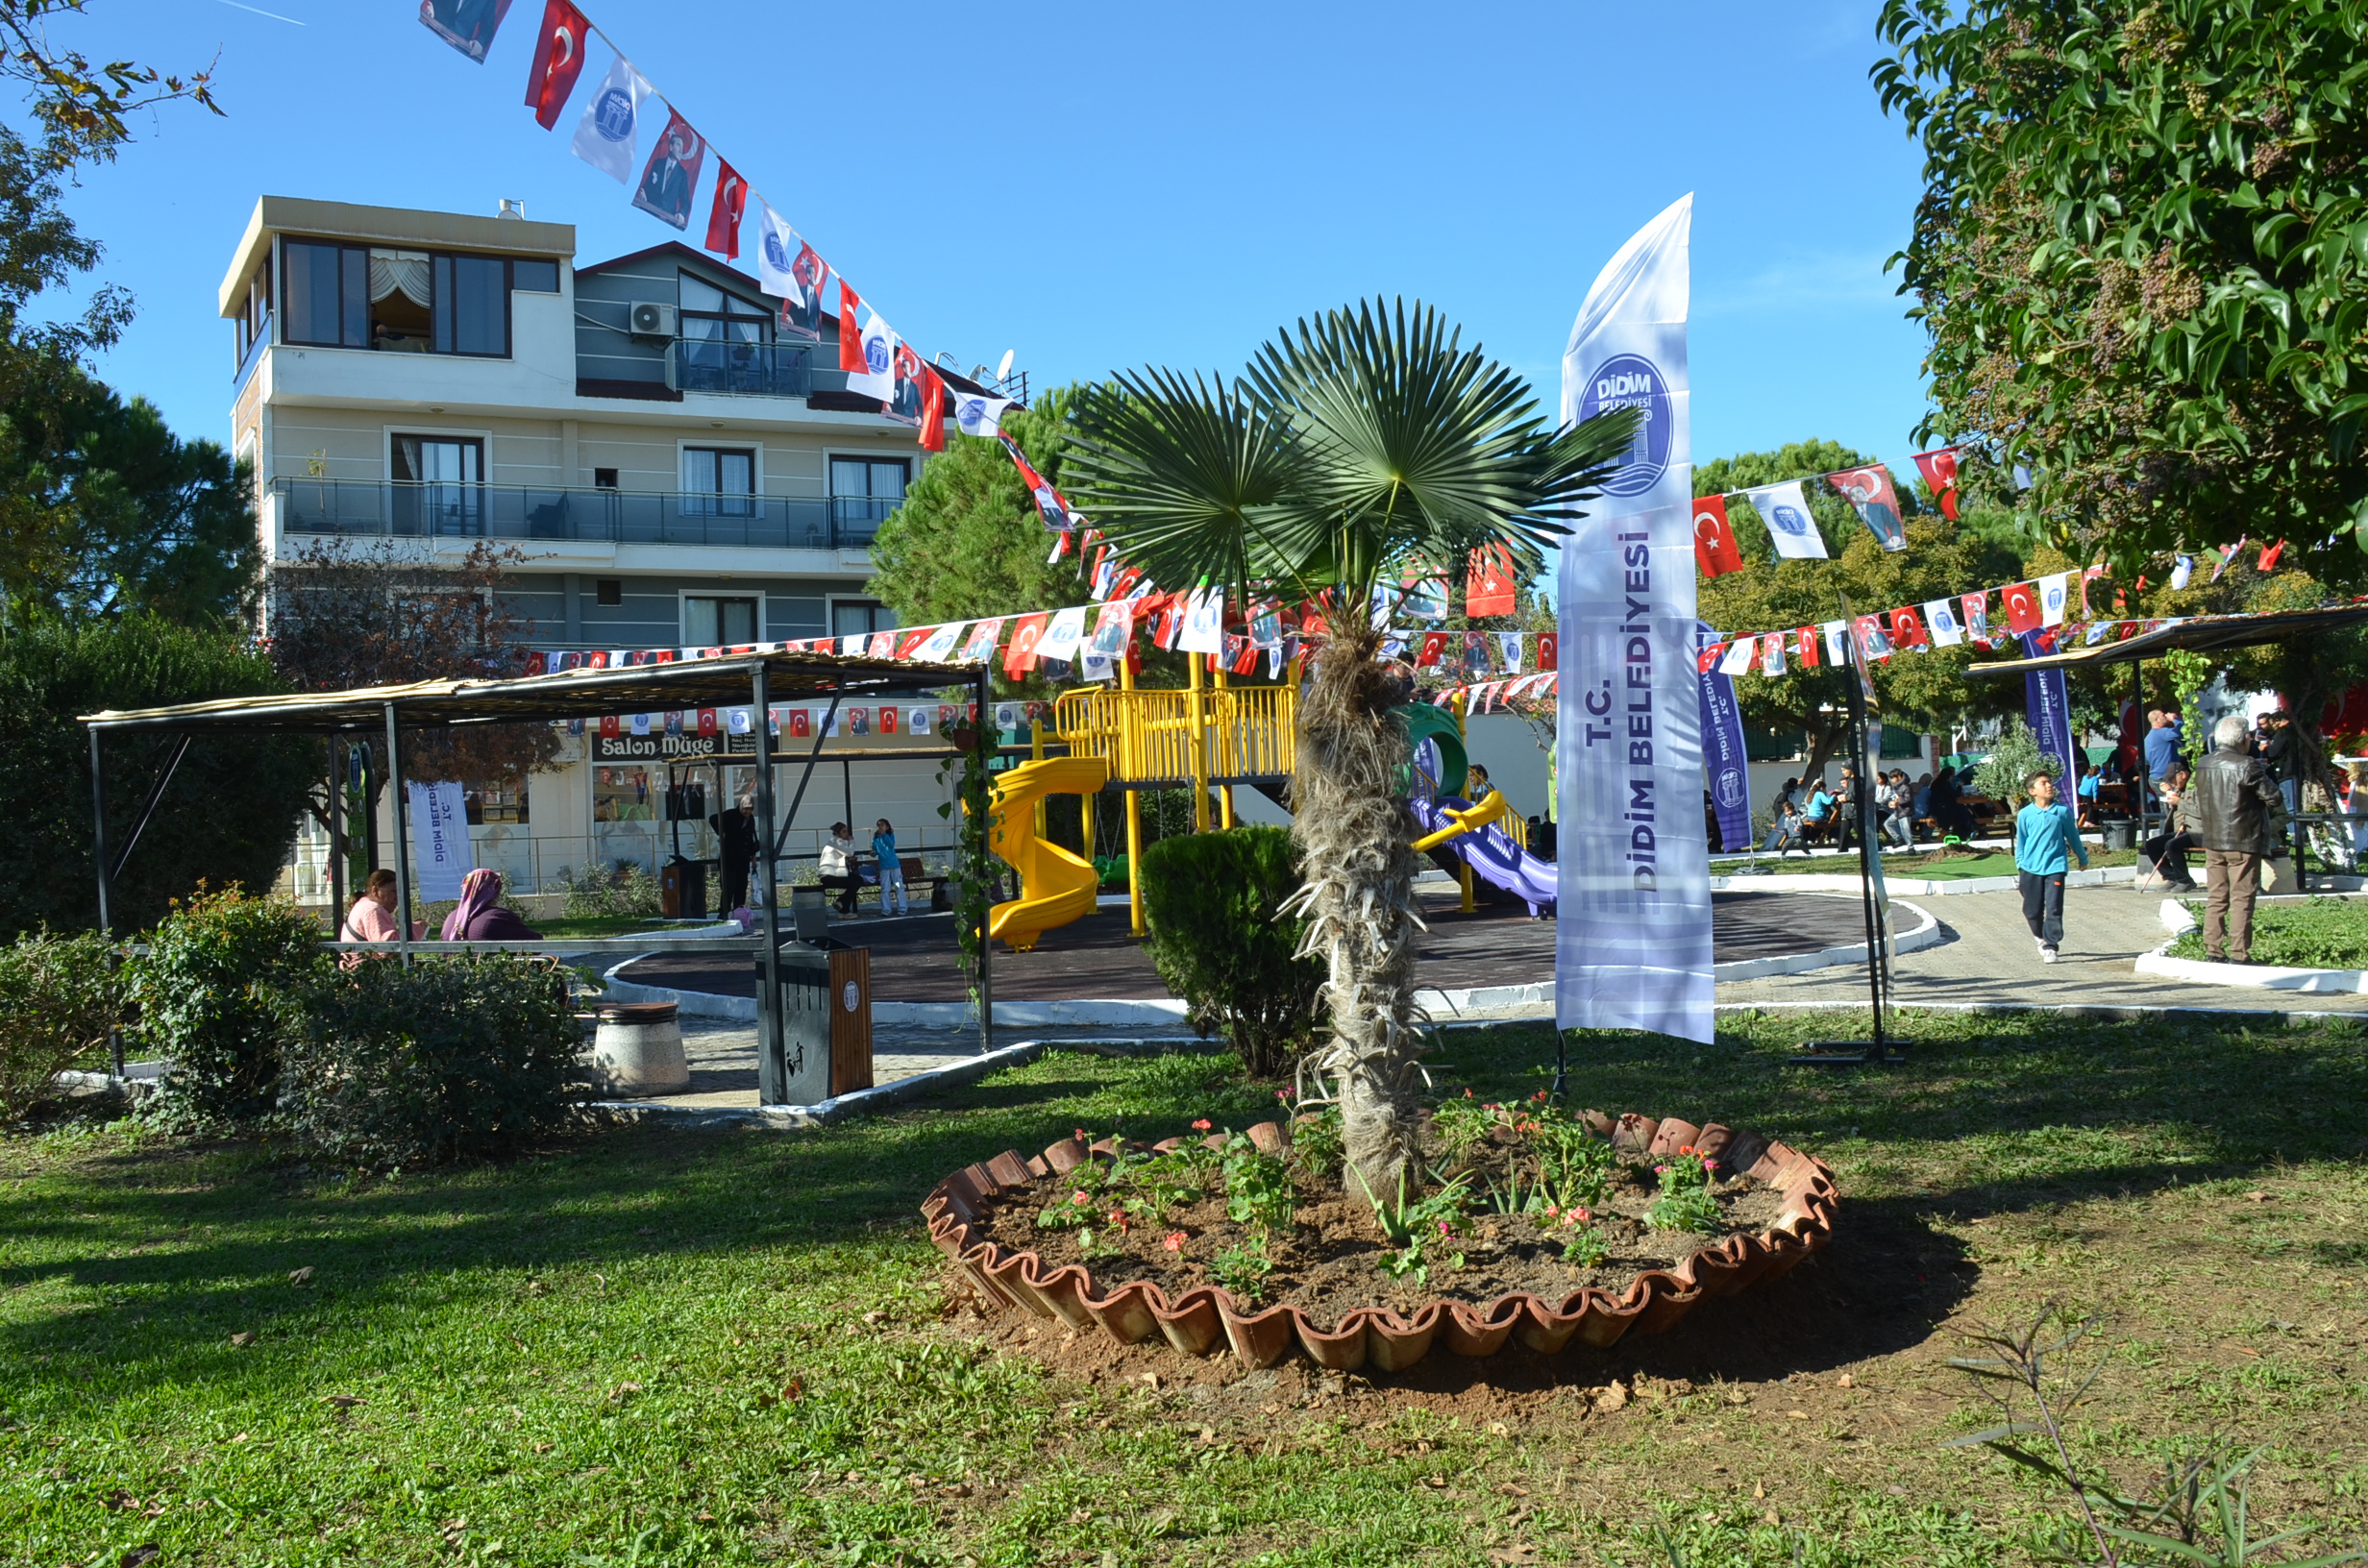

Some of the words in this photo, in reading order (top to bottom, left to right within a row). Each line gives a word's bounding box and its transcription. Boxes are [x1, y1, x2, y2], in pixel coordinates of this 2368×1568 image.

[1597, 371, 1651, 400] DİDİM
[1617, 532, 1653, 765] BELEDİYESİ
[602, 737, 656, 756] Salon
[661, 736, 714, 757] Müge
[1586, 679, 1612, 747] T.C.
[1624, 779, 1657, 892] DİDİM
